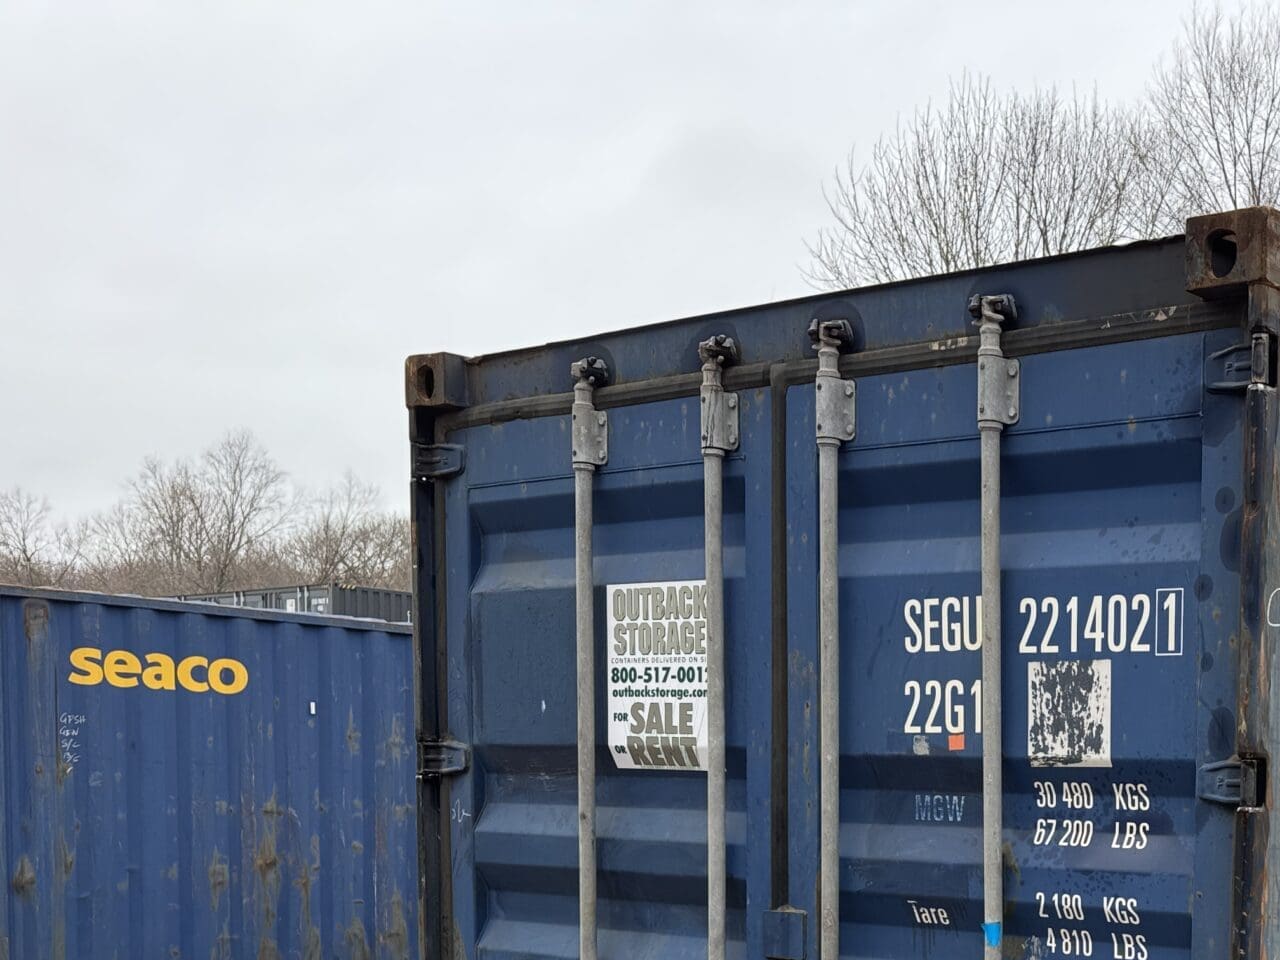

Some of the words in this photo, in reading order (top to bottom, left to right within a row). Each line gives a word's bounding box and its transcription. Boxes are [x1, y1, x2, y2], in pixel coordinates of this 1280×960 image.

[612, 585, 707, 621] OUTBACK
[613, 620, 706, 656] STORAGE
[904, 594, 983, 653] SEGU
[67, 646, 249, 695] seaco
[651, 656, 687, 664] DELIVERED
[613, 712, 628, 722] FOR
[630, 701, 693, 735] SALE
[904, 679, 982, 734] 22G1
[614, 745, 627, 754] OR
[626, 736, 700, 767] RENT
[914, 794, 966, 822] MGW
[1033, 781, 1056, 808] 30
[1062, 782, 1094, 809] 480
[1112, 782, 1150, 811] KGS
[1033, 819, 1056, 846] 67
[1059, 819, 1094, 848] 200
[1111, 822, 1150, 850] LBS
[907, 900, 950, 926] Tare
[1053, 893, 1084, 921] 180
[1103, 896, 1141, 925] KGS
[1062, 928, 1093, 957] 810
